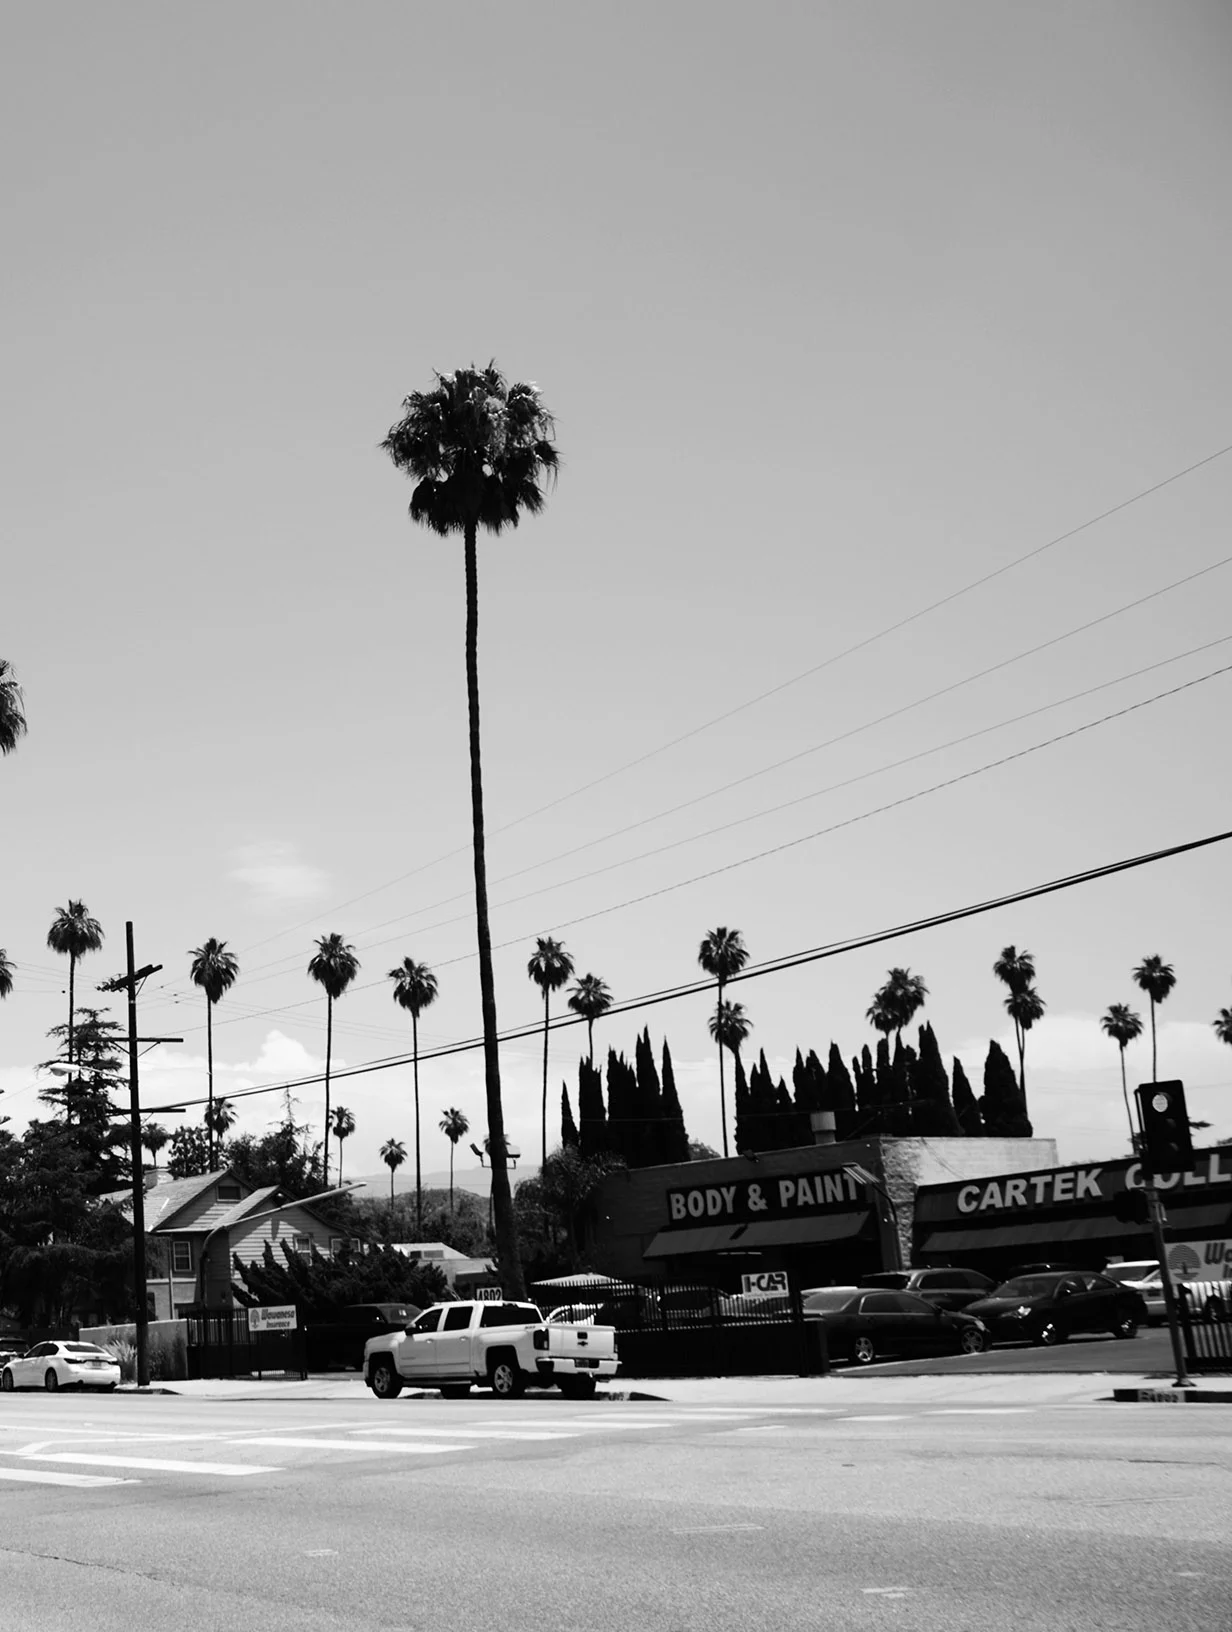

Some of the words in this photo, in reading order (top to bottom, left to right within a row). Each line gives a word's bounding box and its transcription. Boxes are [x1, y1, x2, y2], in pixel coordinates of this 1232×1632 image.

[670, 1185, 736, 1220] BODY
[747, 1184, 768, 1211] &
[778, 1173, 858, 1207] PAINT
[957, 1168, 1103, 1213] CARTEK
